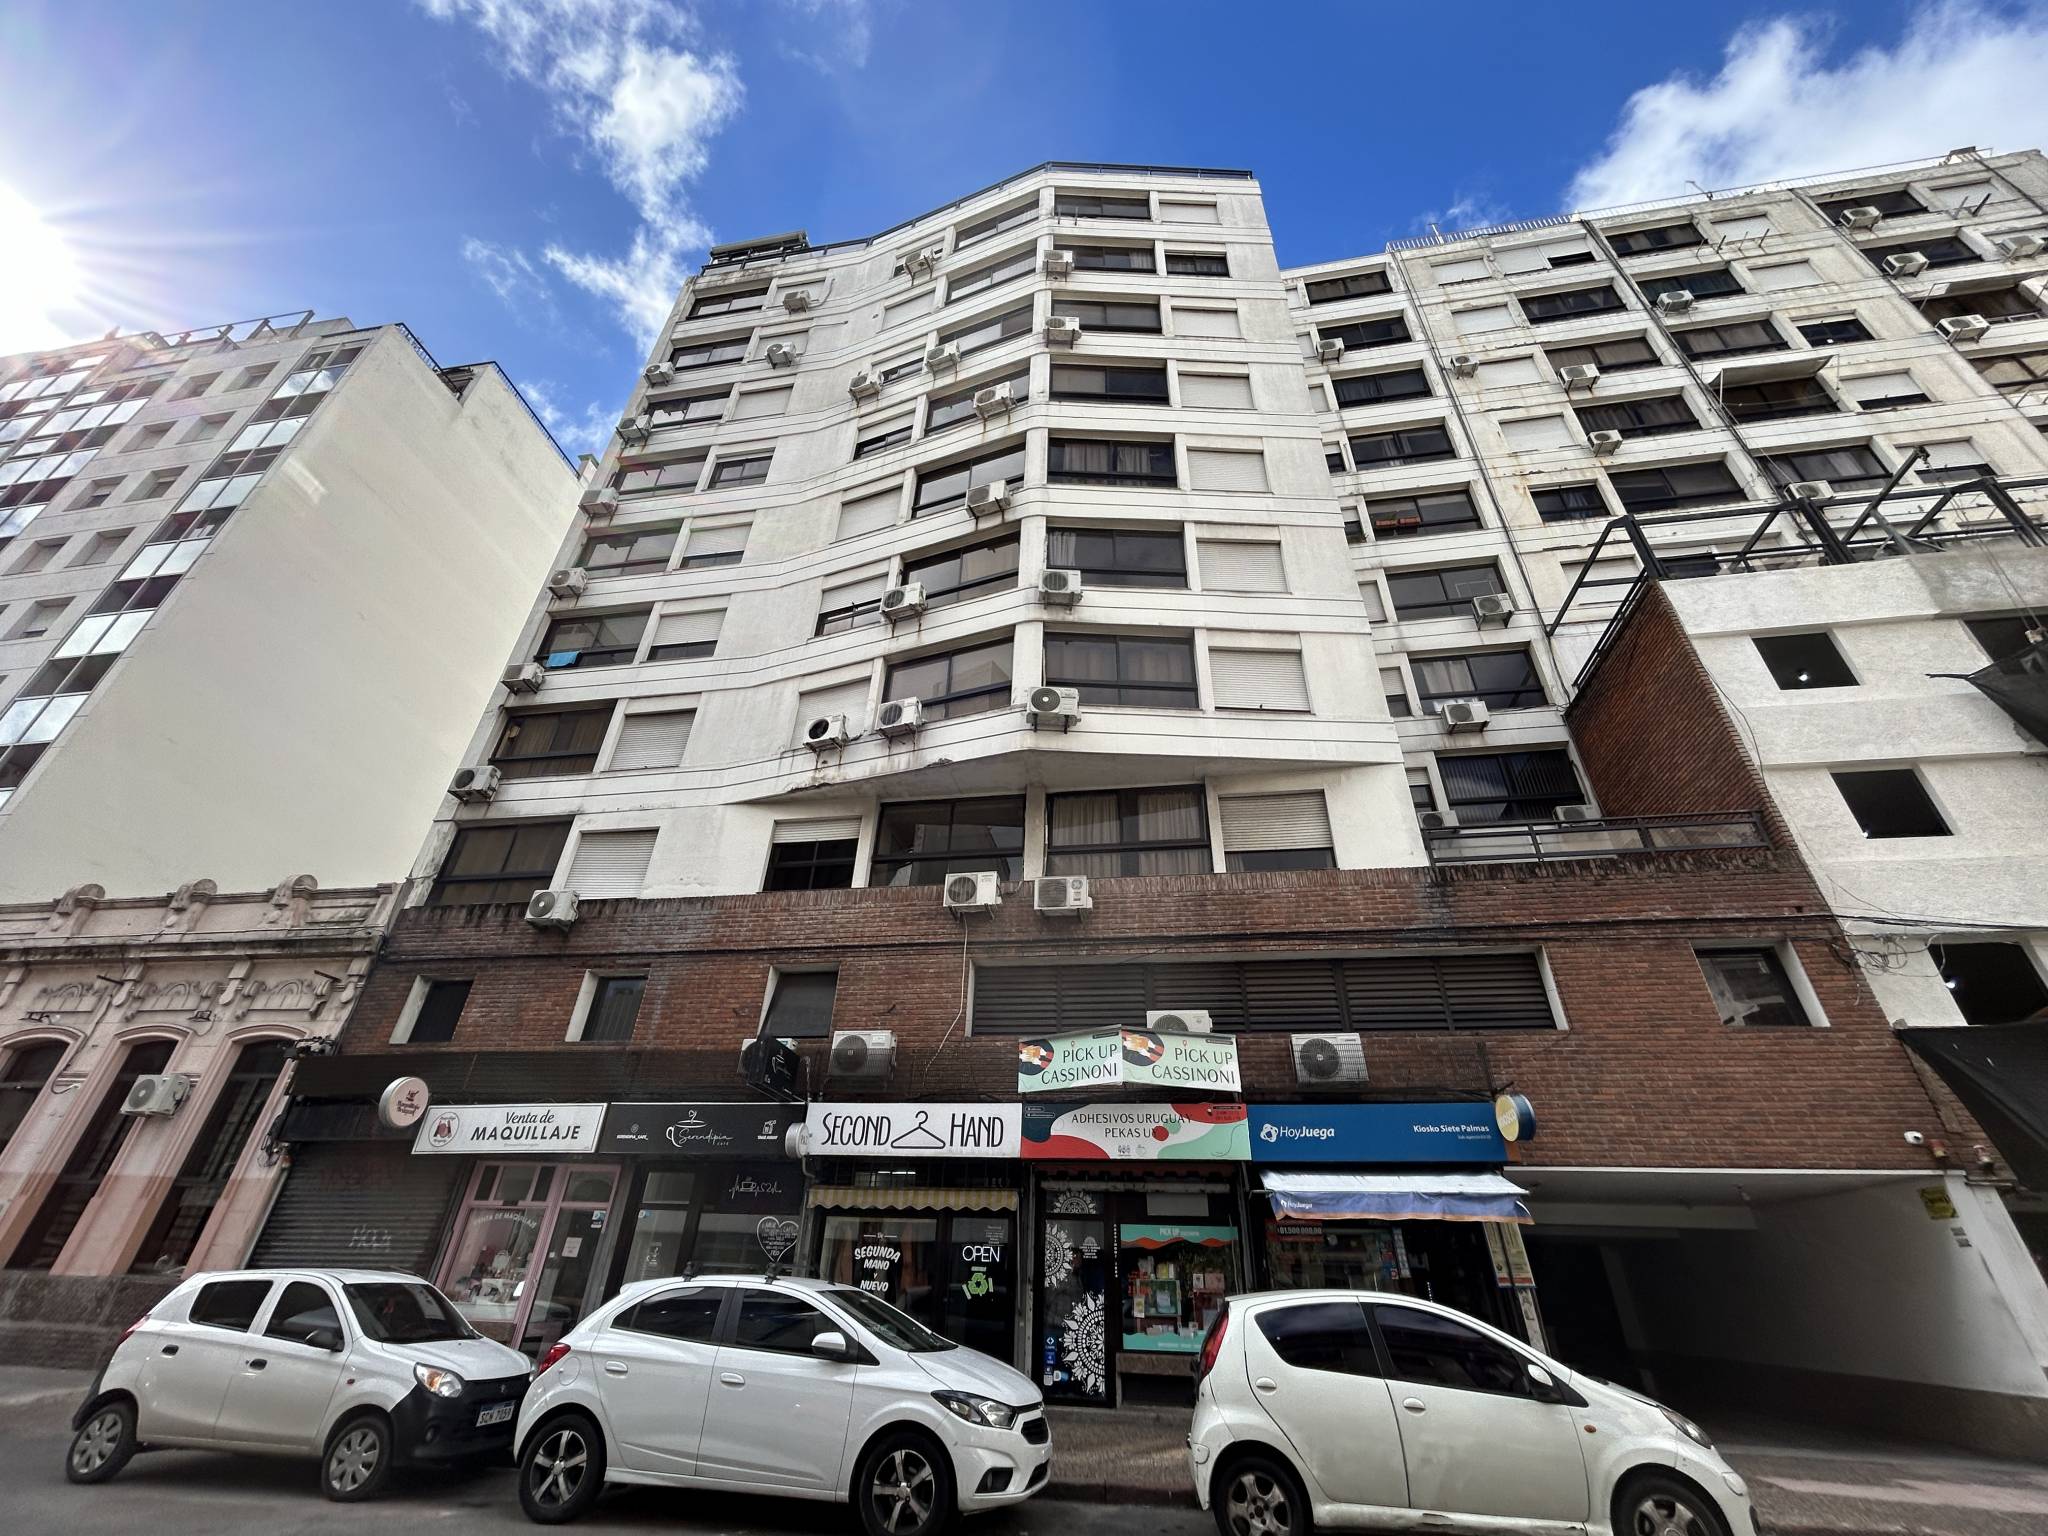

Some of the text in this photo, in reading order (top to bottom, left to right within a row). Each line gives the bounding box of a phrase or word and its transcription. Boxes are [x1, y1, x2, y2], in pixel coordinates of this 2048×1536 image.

[1063, 1044, 1118, 1063] PICK UP
[1175, 1048, 1233, 1065] PICK UP
[1041, 1062, 1118, 1084] CASSINONI
[1152, 1064, 1235, 1084] CASSINONI
[506, 1109, 555, 1124] Venta de
[1072, 1113, 1192, 1124] ADHESIVOS URUGUAY
[470, 1126, 580, 1141] MAQUILLAJE
[821, 1112, 1004, 1147] SECOND HAND
[1105, 1128, 1141, 1138] PEKAS
[1280, 1126, 1335, 1140] HoyJuega
[1413, 1125, 1440, 1133] Kiosko
[854, 1245, 901, 1263] SEGUNDA
[962, 1245, 1000, 1262] OPEN
[863, 1258, 890, 1270] MANO
[860, 1279, 889, 1292] NUEVO
